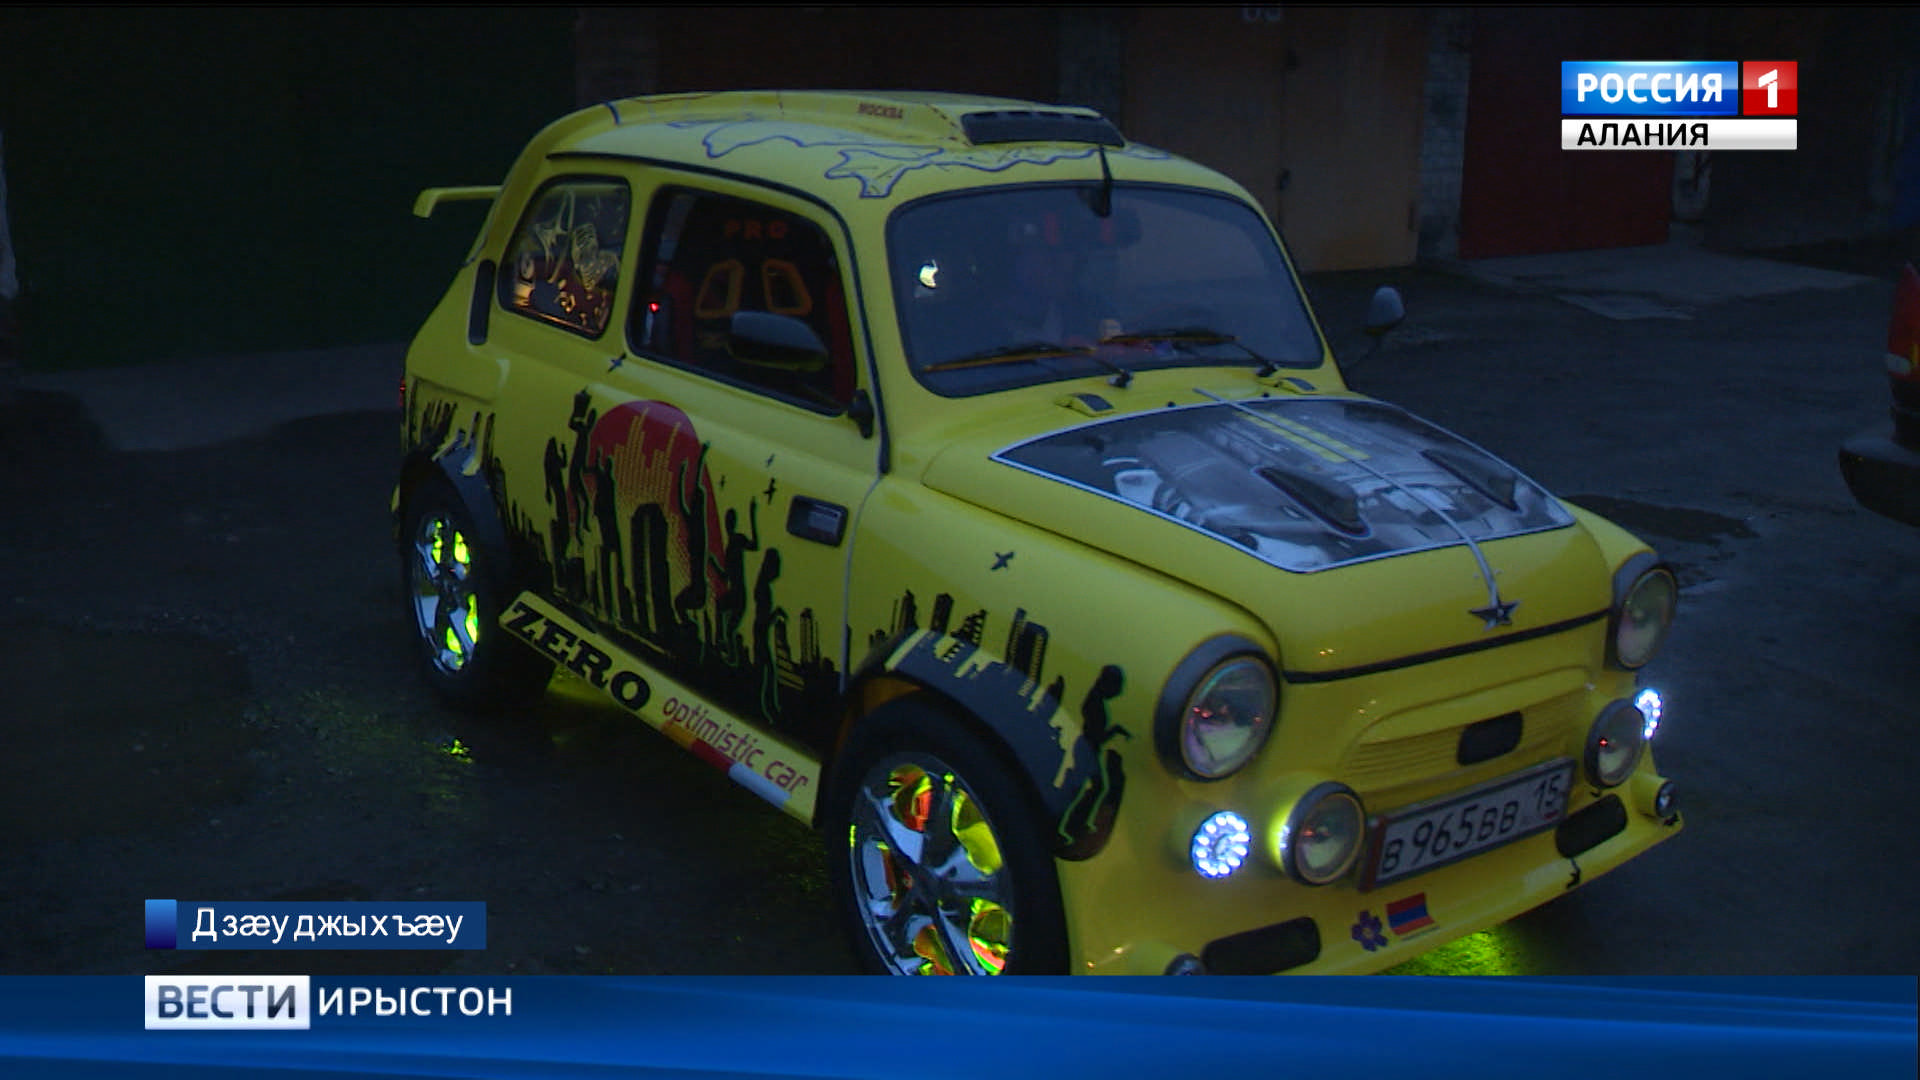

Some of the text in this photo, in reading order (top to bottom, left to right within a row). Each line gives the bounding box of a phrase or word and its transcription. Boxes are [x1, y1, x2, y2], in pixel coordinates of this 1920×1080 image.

[508, 601, 651, 711] ZERO
[661, 697, 808, 792] optimistic car
[1534, 774, 1561, 813] 15
